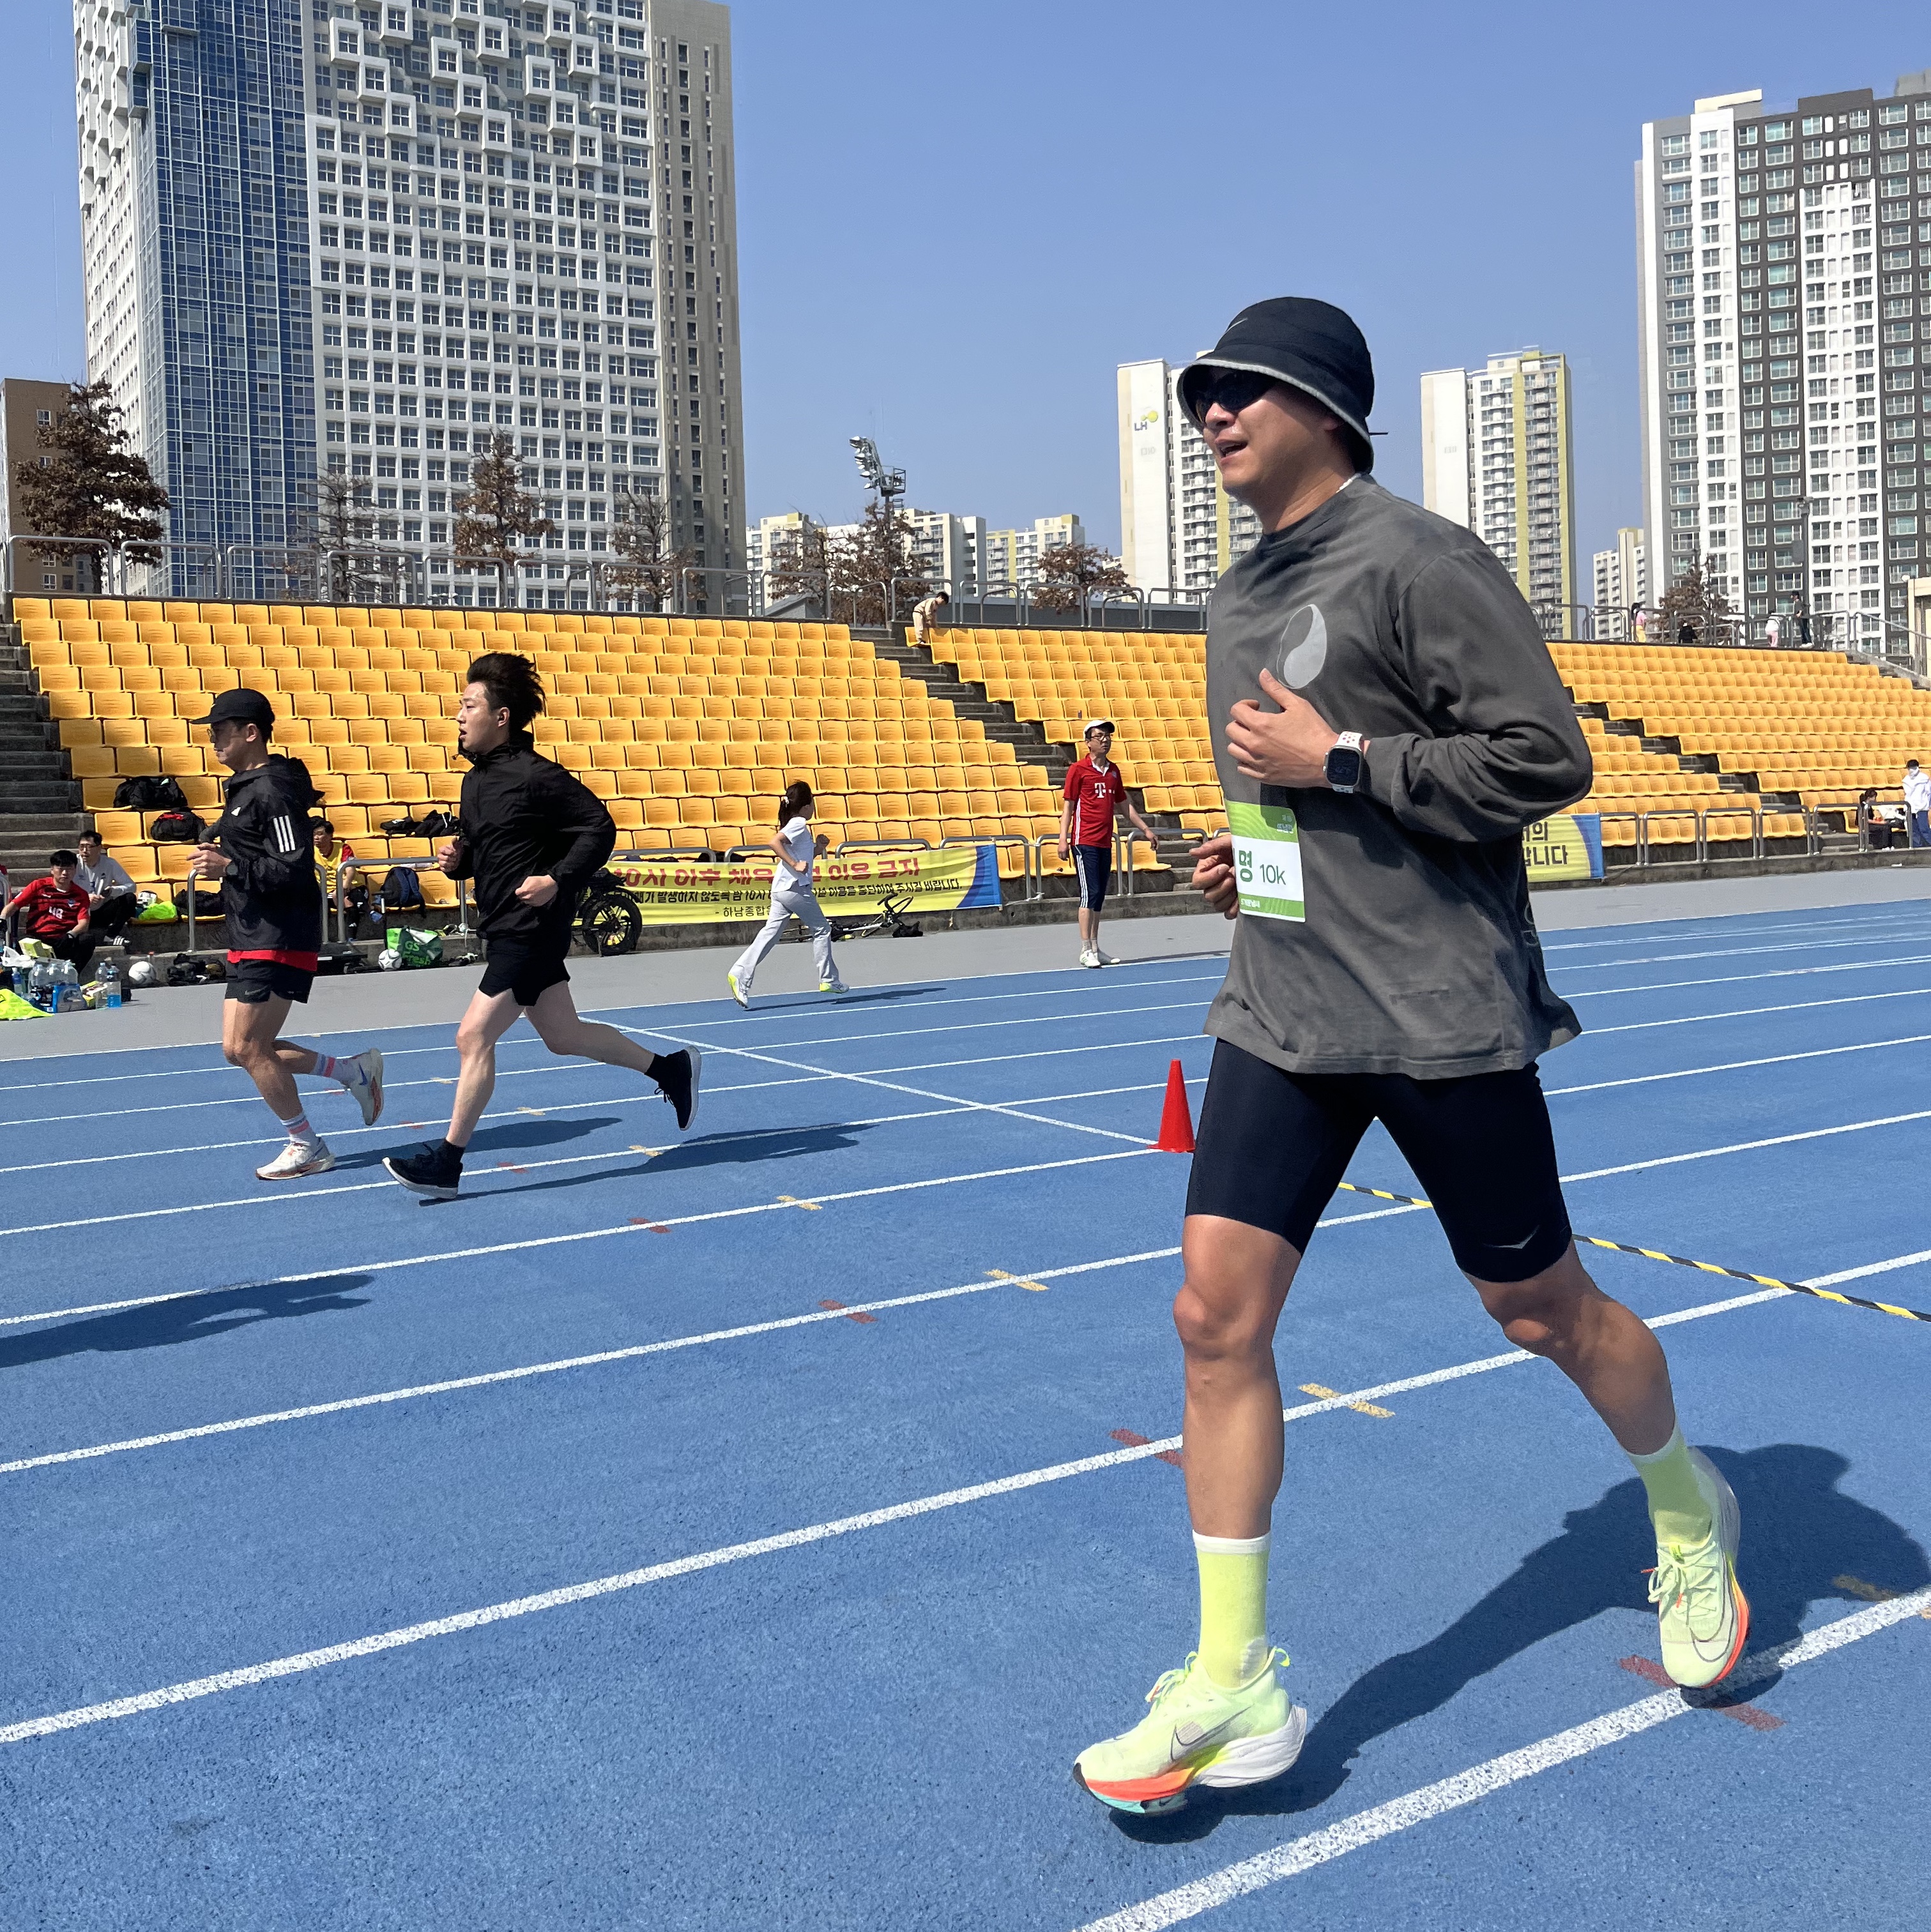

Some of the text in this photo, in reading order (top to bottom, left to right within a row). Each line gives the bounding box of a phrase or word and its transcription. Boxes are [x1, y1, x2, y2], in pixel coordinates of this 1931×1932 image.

[1134, 422, 1147, 431] LH
[675, 869, 722, 886] 이후
[828, 863, 871, 881] 이용
[878, 858, 920, 879] 금지
[1233, 848, 1253, 883] 명
[1259, 864, 1286, 885] 10k
[404, 940, 420, 952] GS
